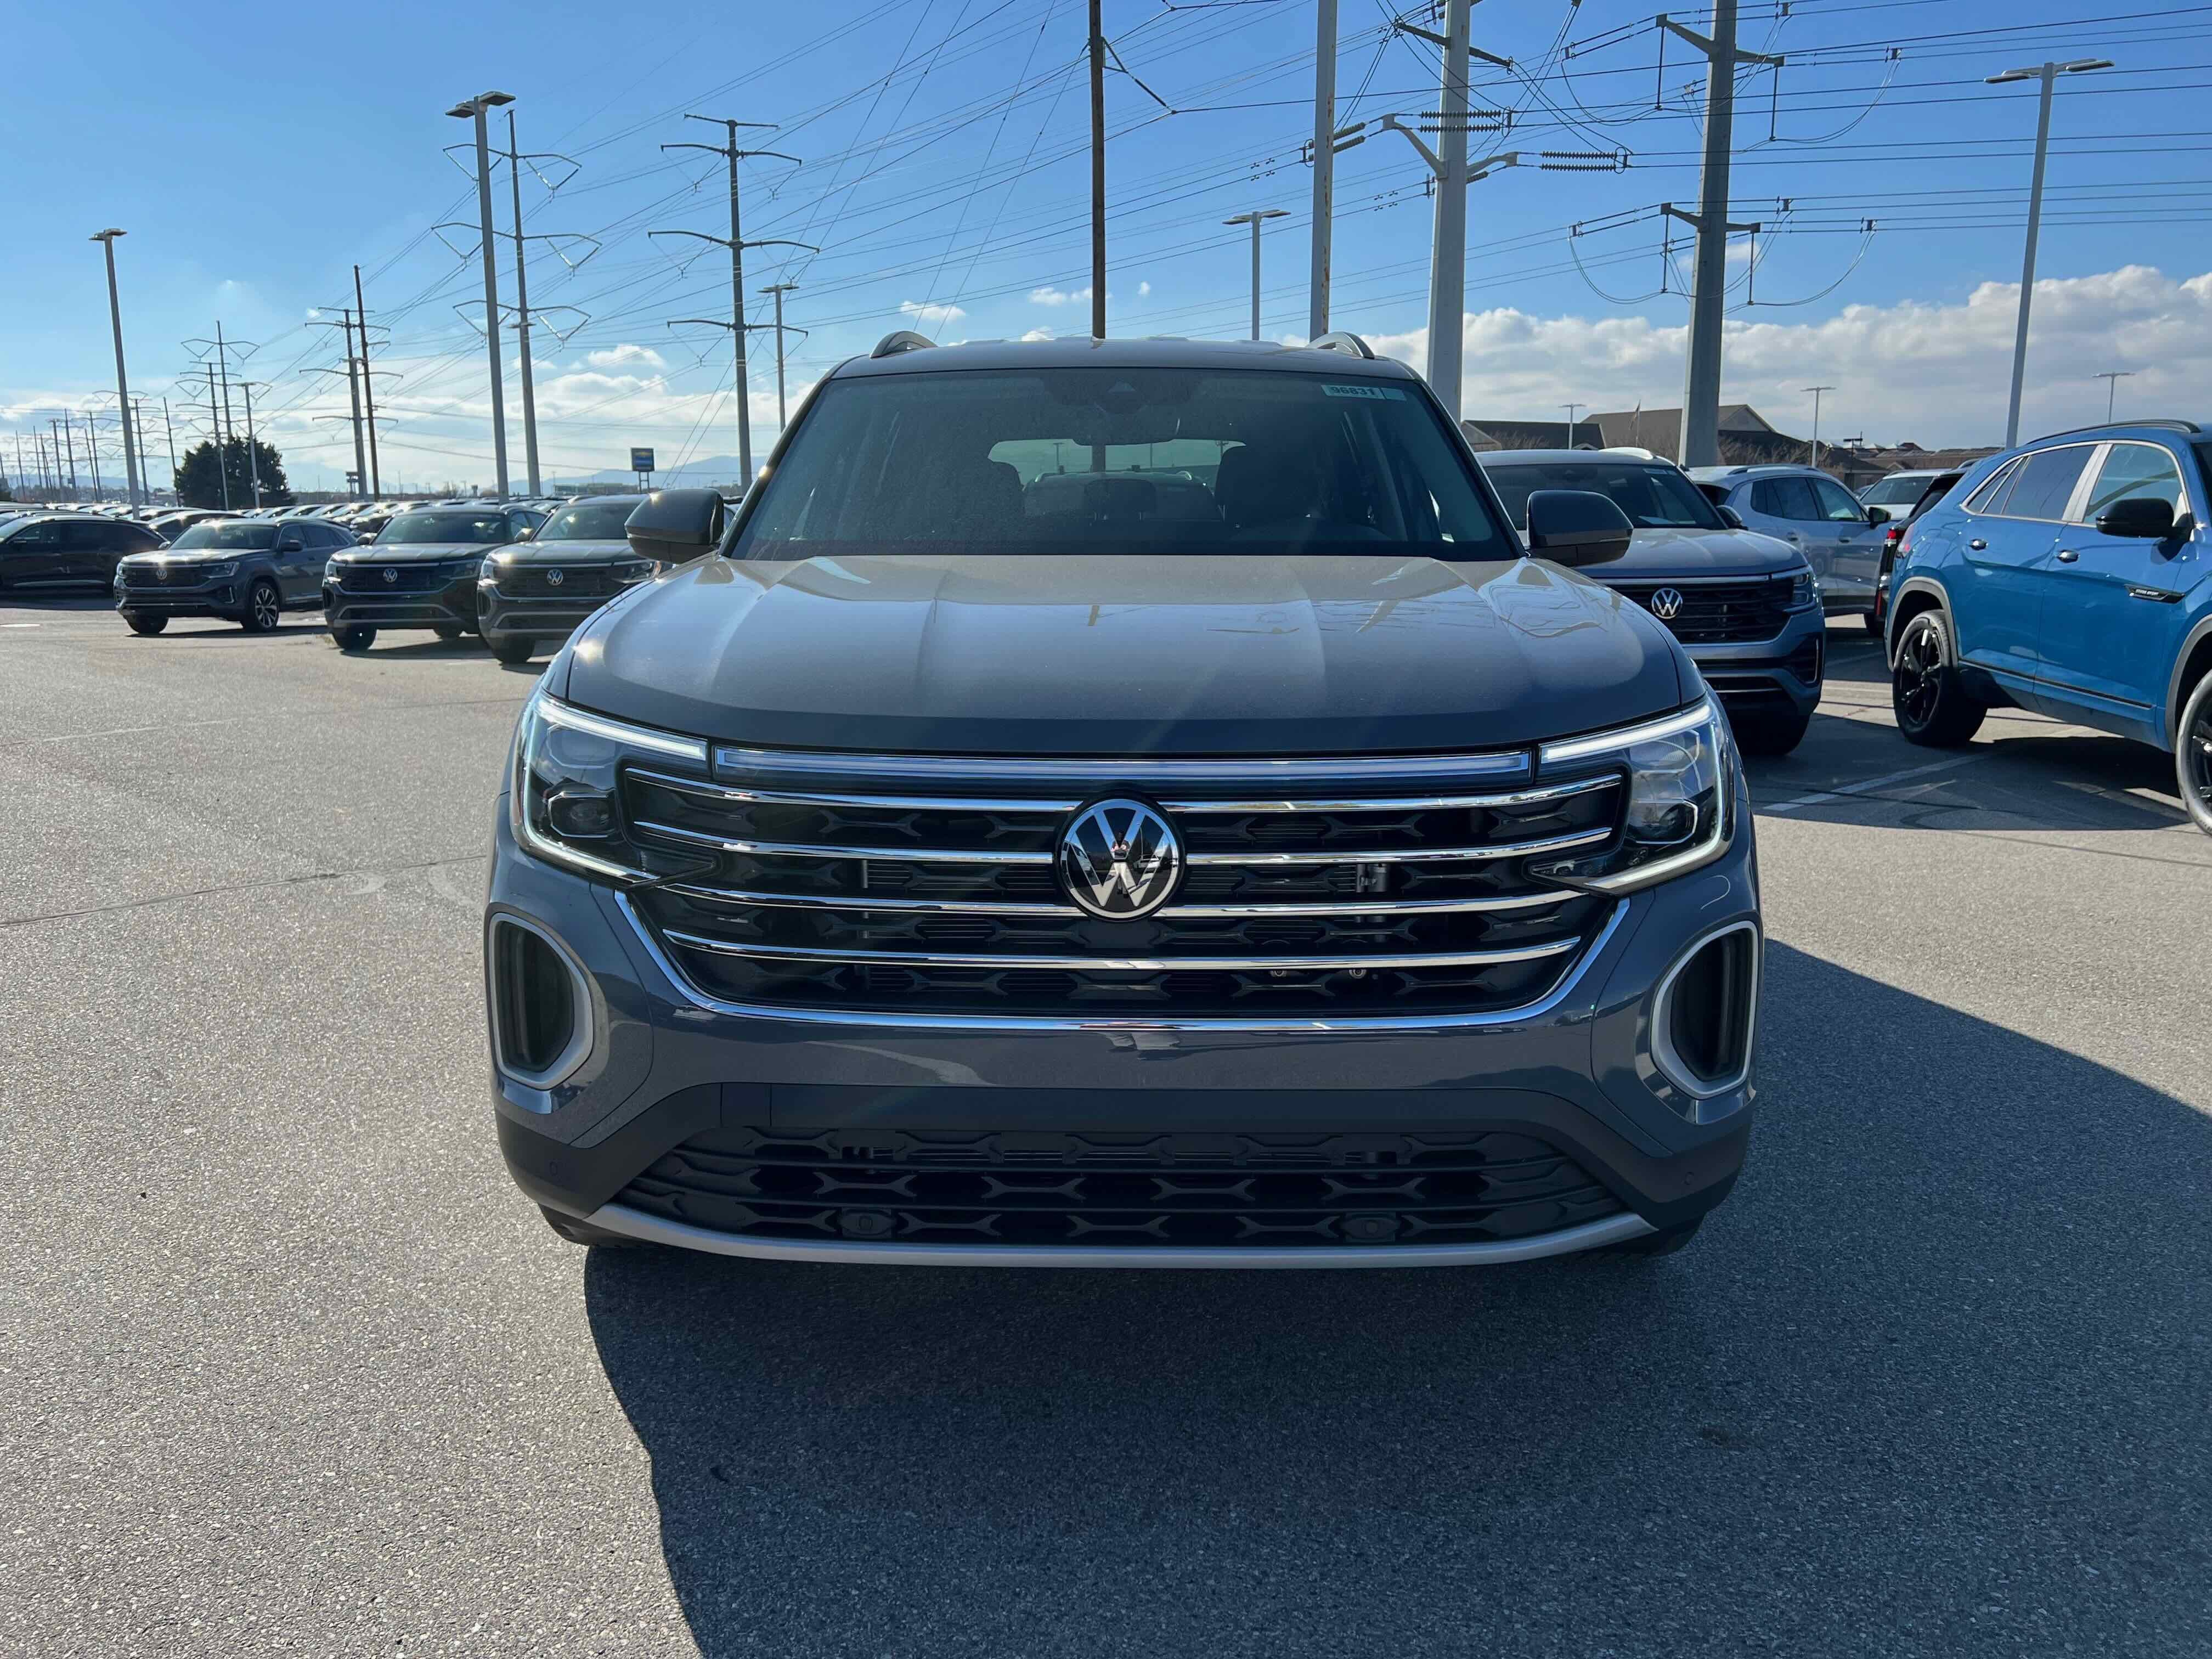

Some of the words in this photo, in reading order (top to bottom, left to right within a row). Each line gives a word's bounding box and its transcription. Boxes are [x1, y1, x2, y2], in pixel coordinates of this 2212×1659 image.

[1330, 386, 1374, 396] 96831
[1651, 588, 1683, 619] VW
[1061, 799, 1178, 917] VW
